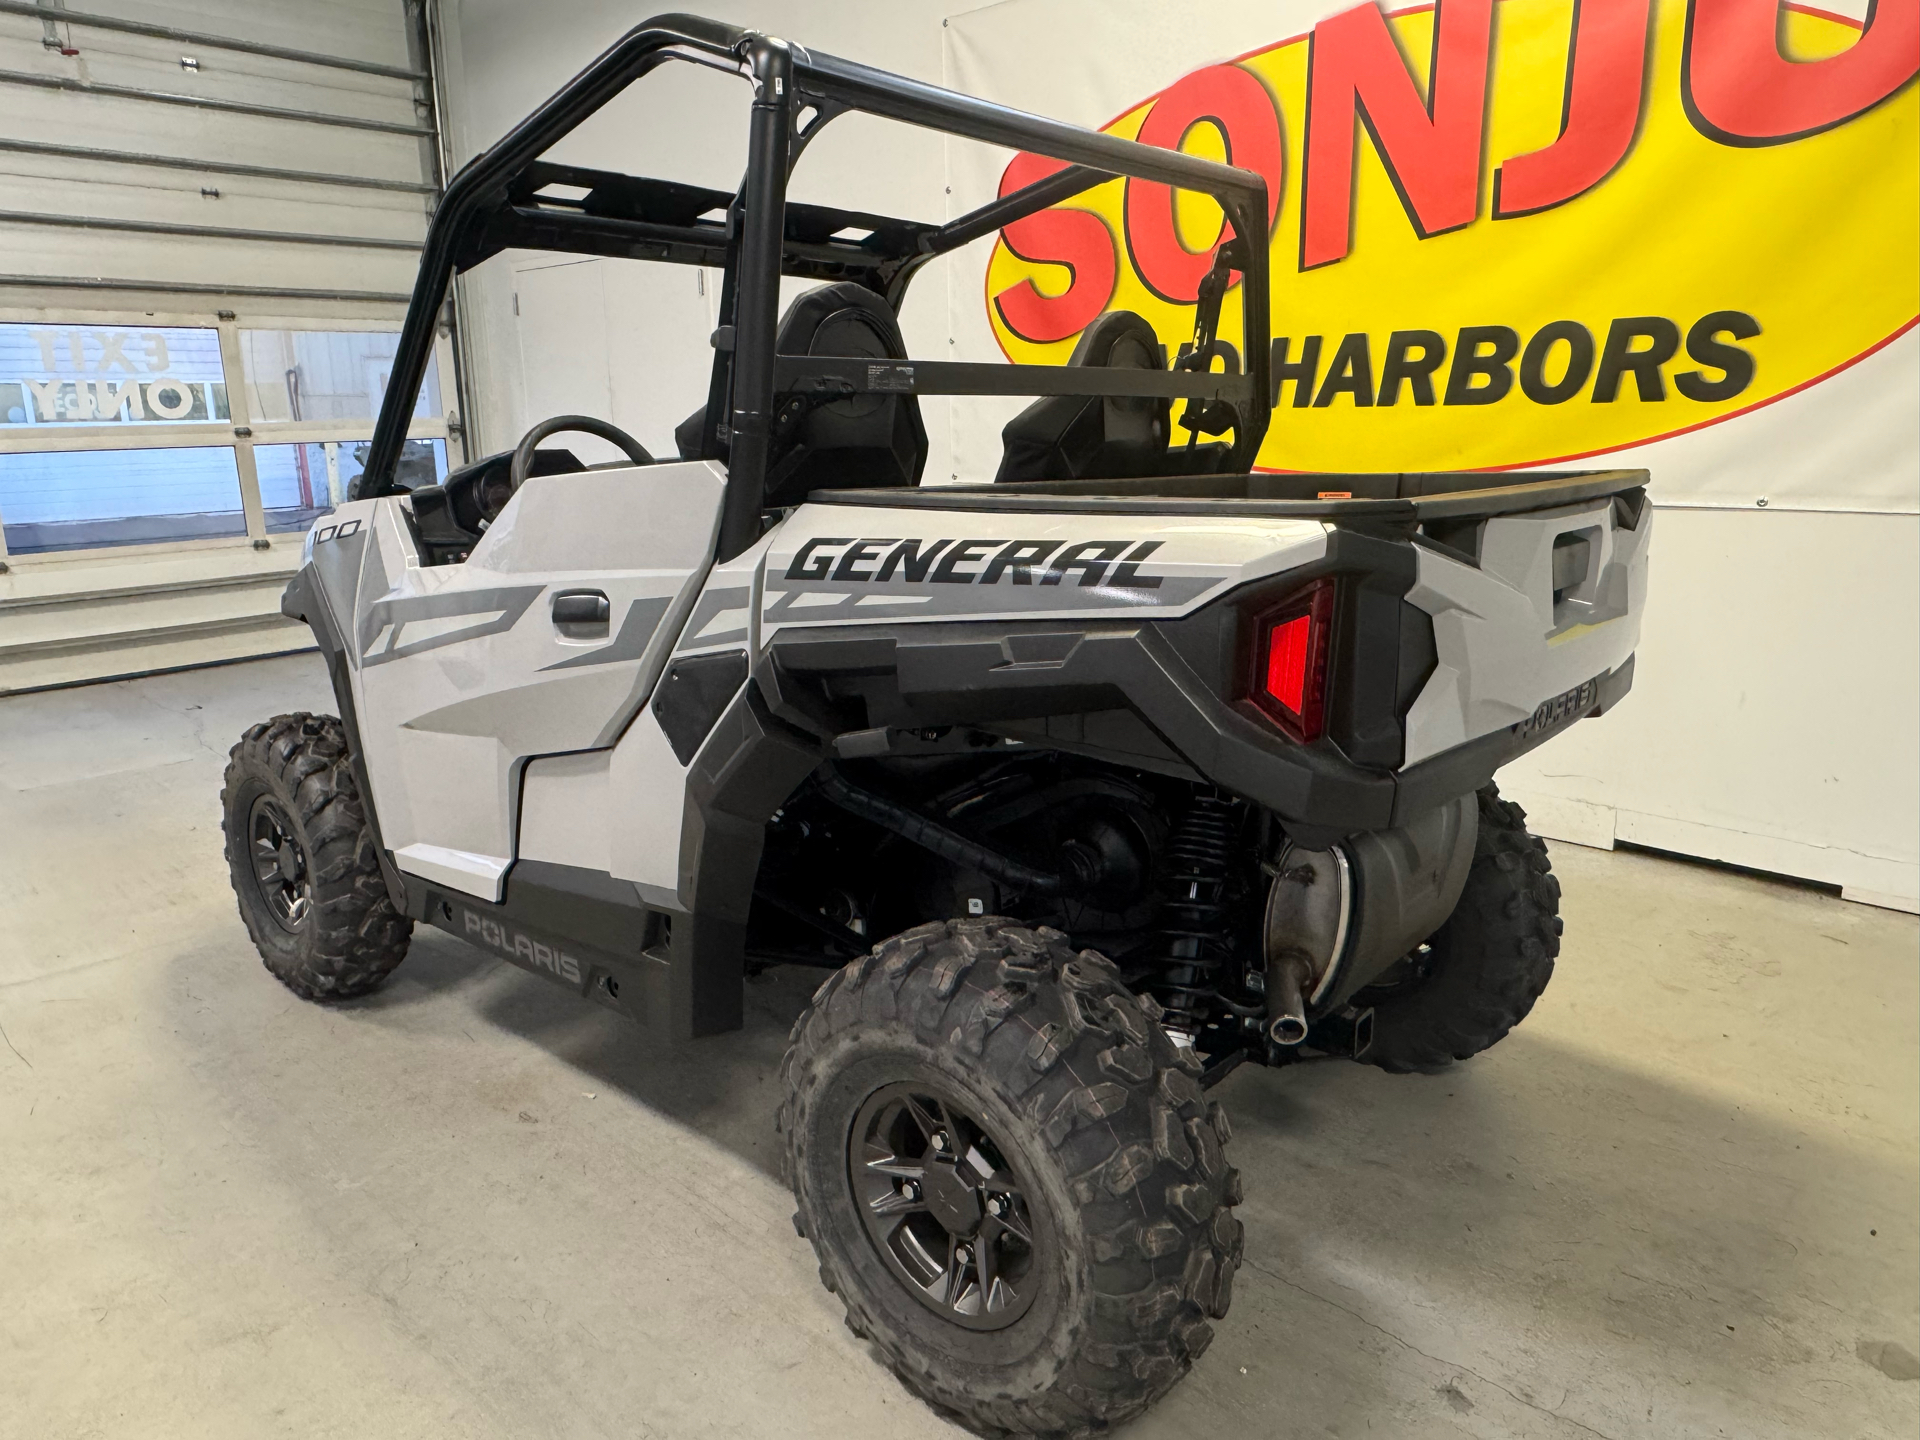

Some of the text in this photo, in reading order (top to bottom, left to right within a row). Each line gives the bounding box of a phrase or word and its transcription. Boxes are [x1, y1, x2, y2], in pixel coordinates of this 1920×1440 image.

[1270, 310, 1762, 409] HARBORS
[784, 536, 1167, 589] GENERAL
[463, 908, 583, 985] POLARIS
